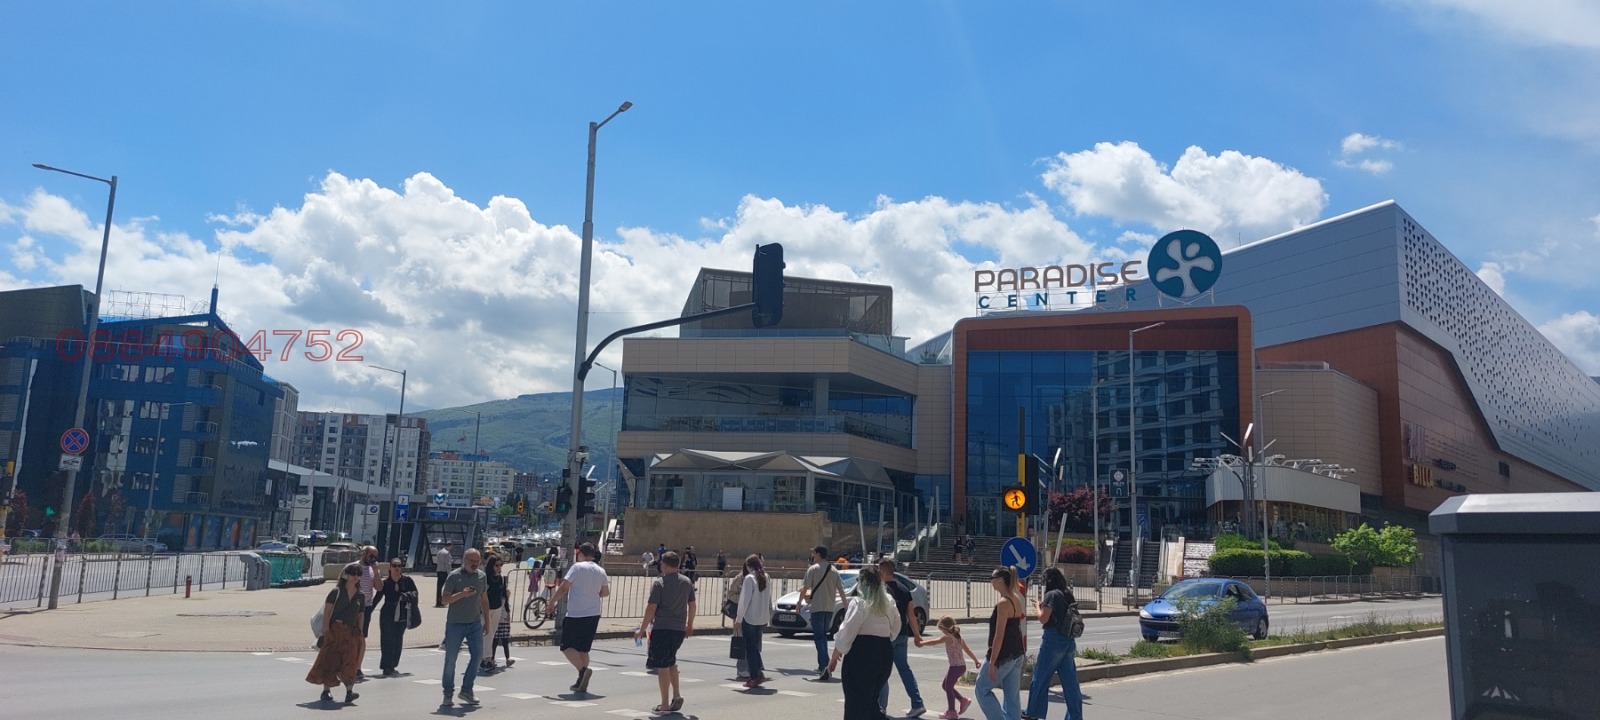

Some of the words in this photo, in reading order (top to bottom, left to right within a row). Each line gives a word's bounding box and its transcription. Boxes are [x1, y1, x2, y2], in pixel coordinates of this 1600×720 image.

[974, 260, 1142, 292] PARADISE
[978, 288, 1137, 309] CENTER
[1413, 464, 1434, 488] BILLA
